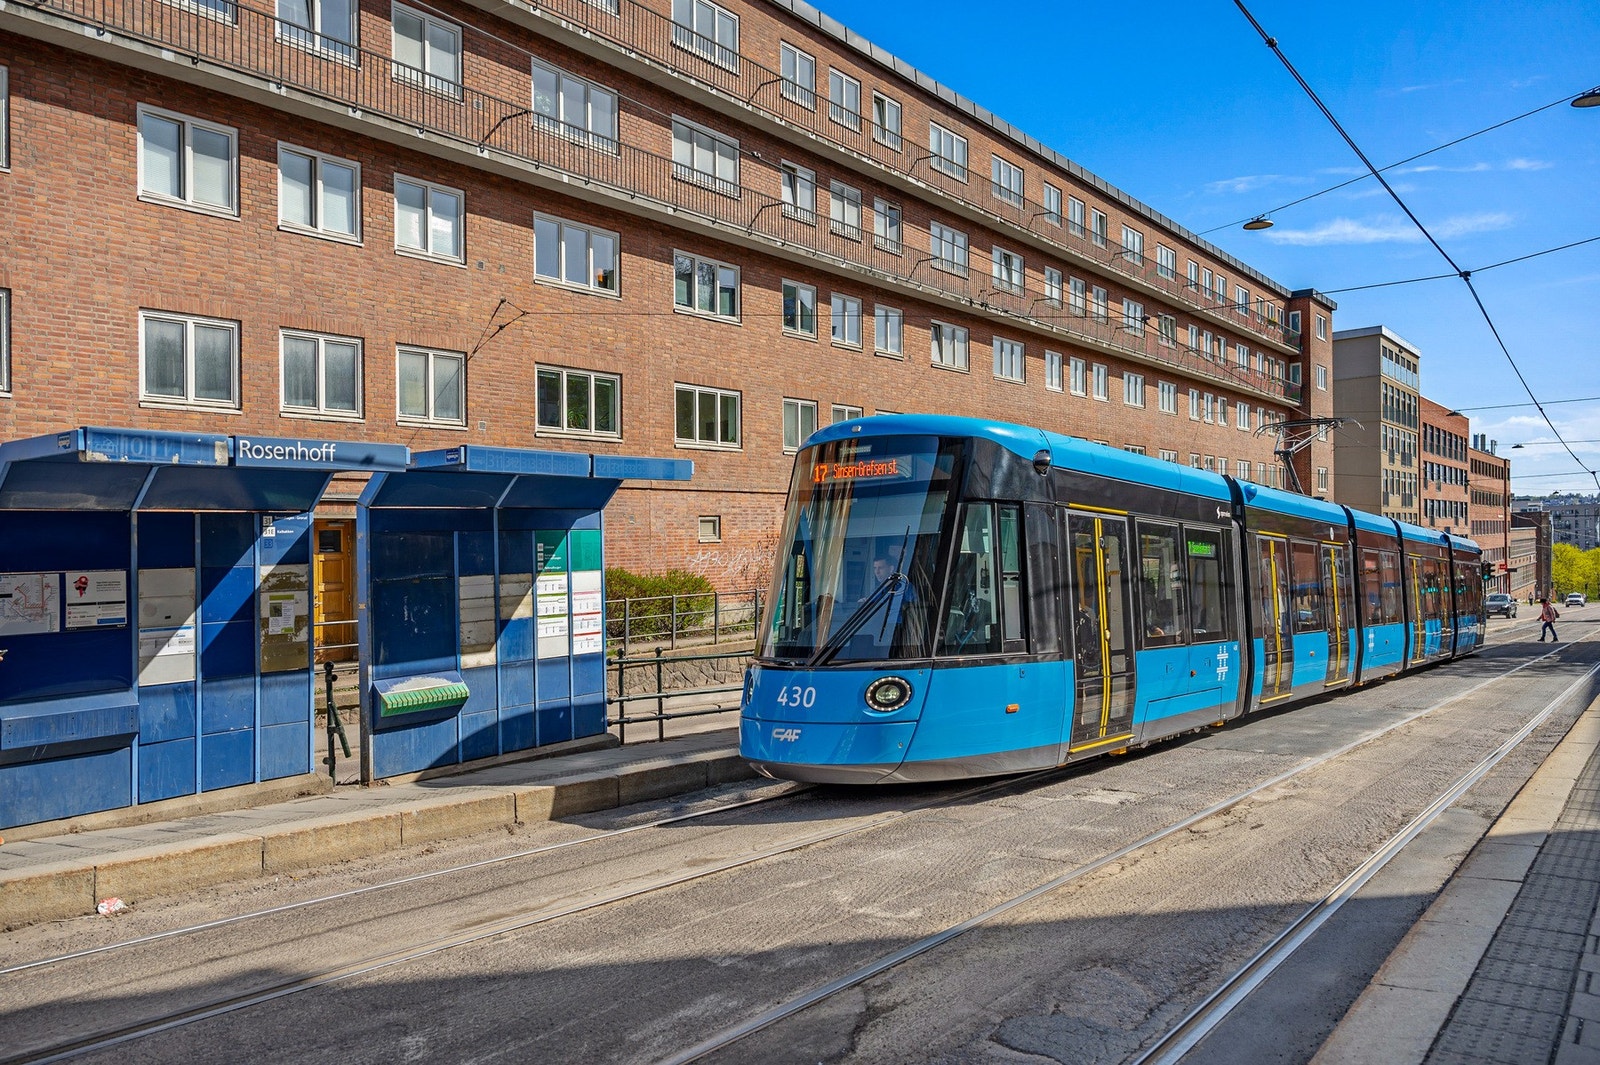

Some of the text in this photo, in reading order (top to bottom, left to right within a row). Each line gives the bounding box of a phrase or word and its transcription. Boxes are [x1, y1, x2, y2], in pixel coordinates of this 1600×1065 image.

[239, 440, 336, 462] Rosenhoff
[812, 458, 899, 482] 17 Sinsen-Grefsen st.
[264, 517, 272, 525] 31
[777, 686, 816, 708] 430
[773, 728, 802, 742] CAF
